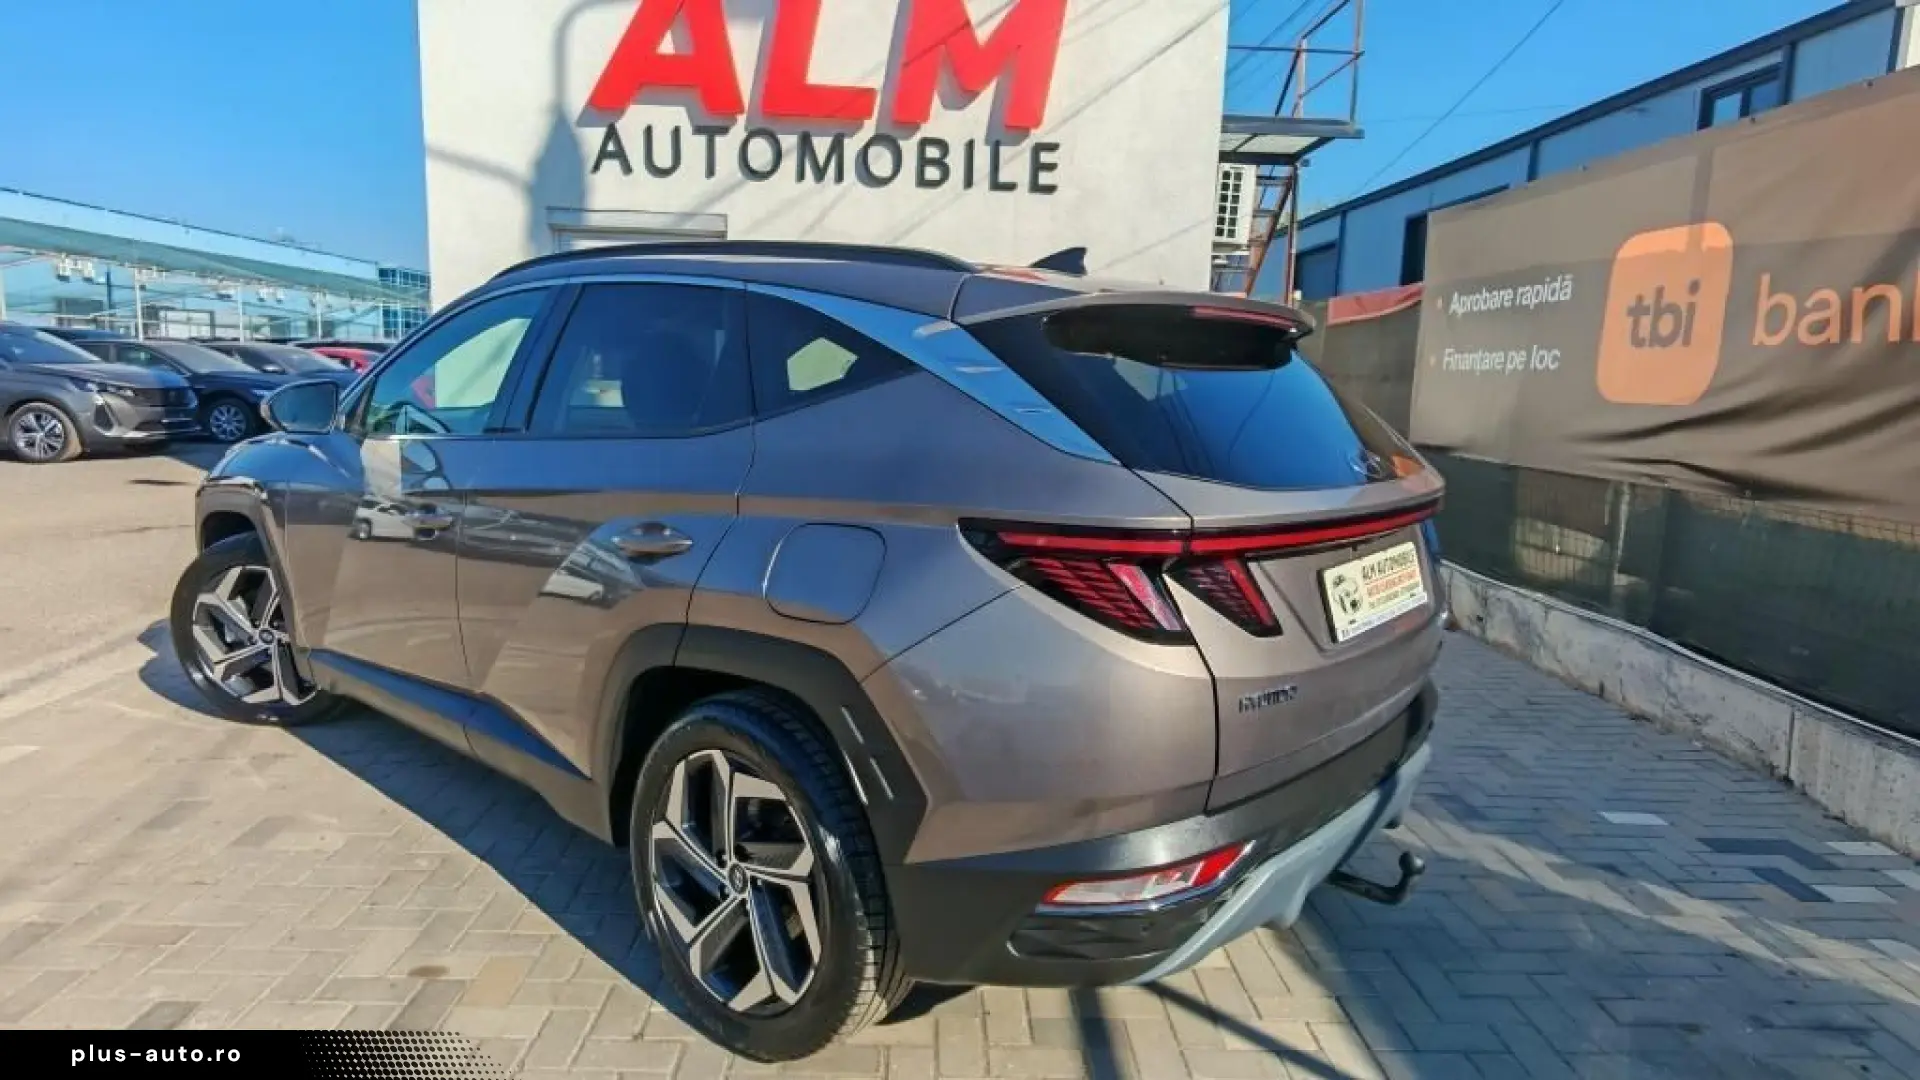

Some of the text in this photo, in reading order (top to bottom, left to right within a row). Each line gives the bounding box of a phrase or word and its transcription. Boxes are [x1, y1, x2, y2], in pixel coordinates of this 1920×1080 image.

[587, 0, 1068, 130] ALM
[591, 122, 1060, 195] AUTOMOBILE
[1449, 273, 1573, 319] Aprobare rapidă
[1626, 279, 1700, 348] tbi
[1443, 344, 1561, 375] Finanțare pe loc
